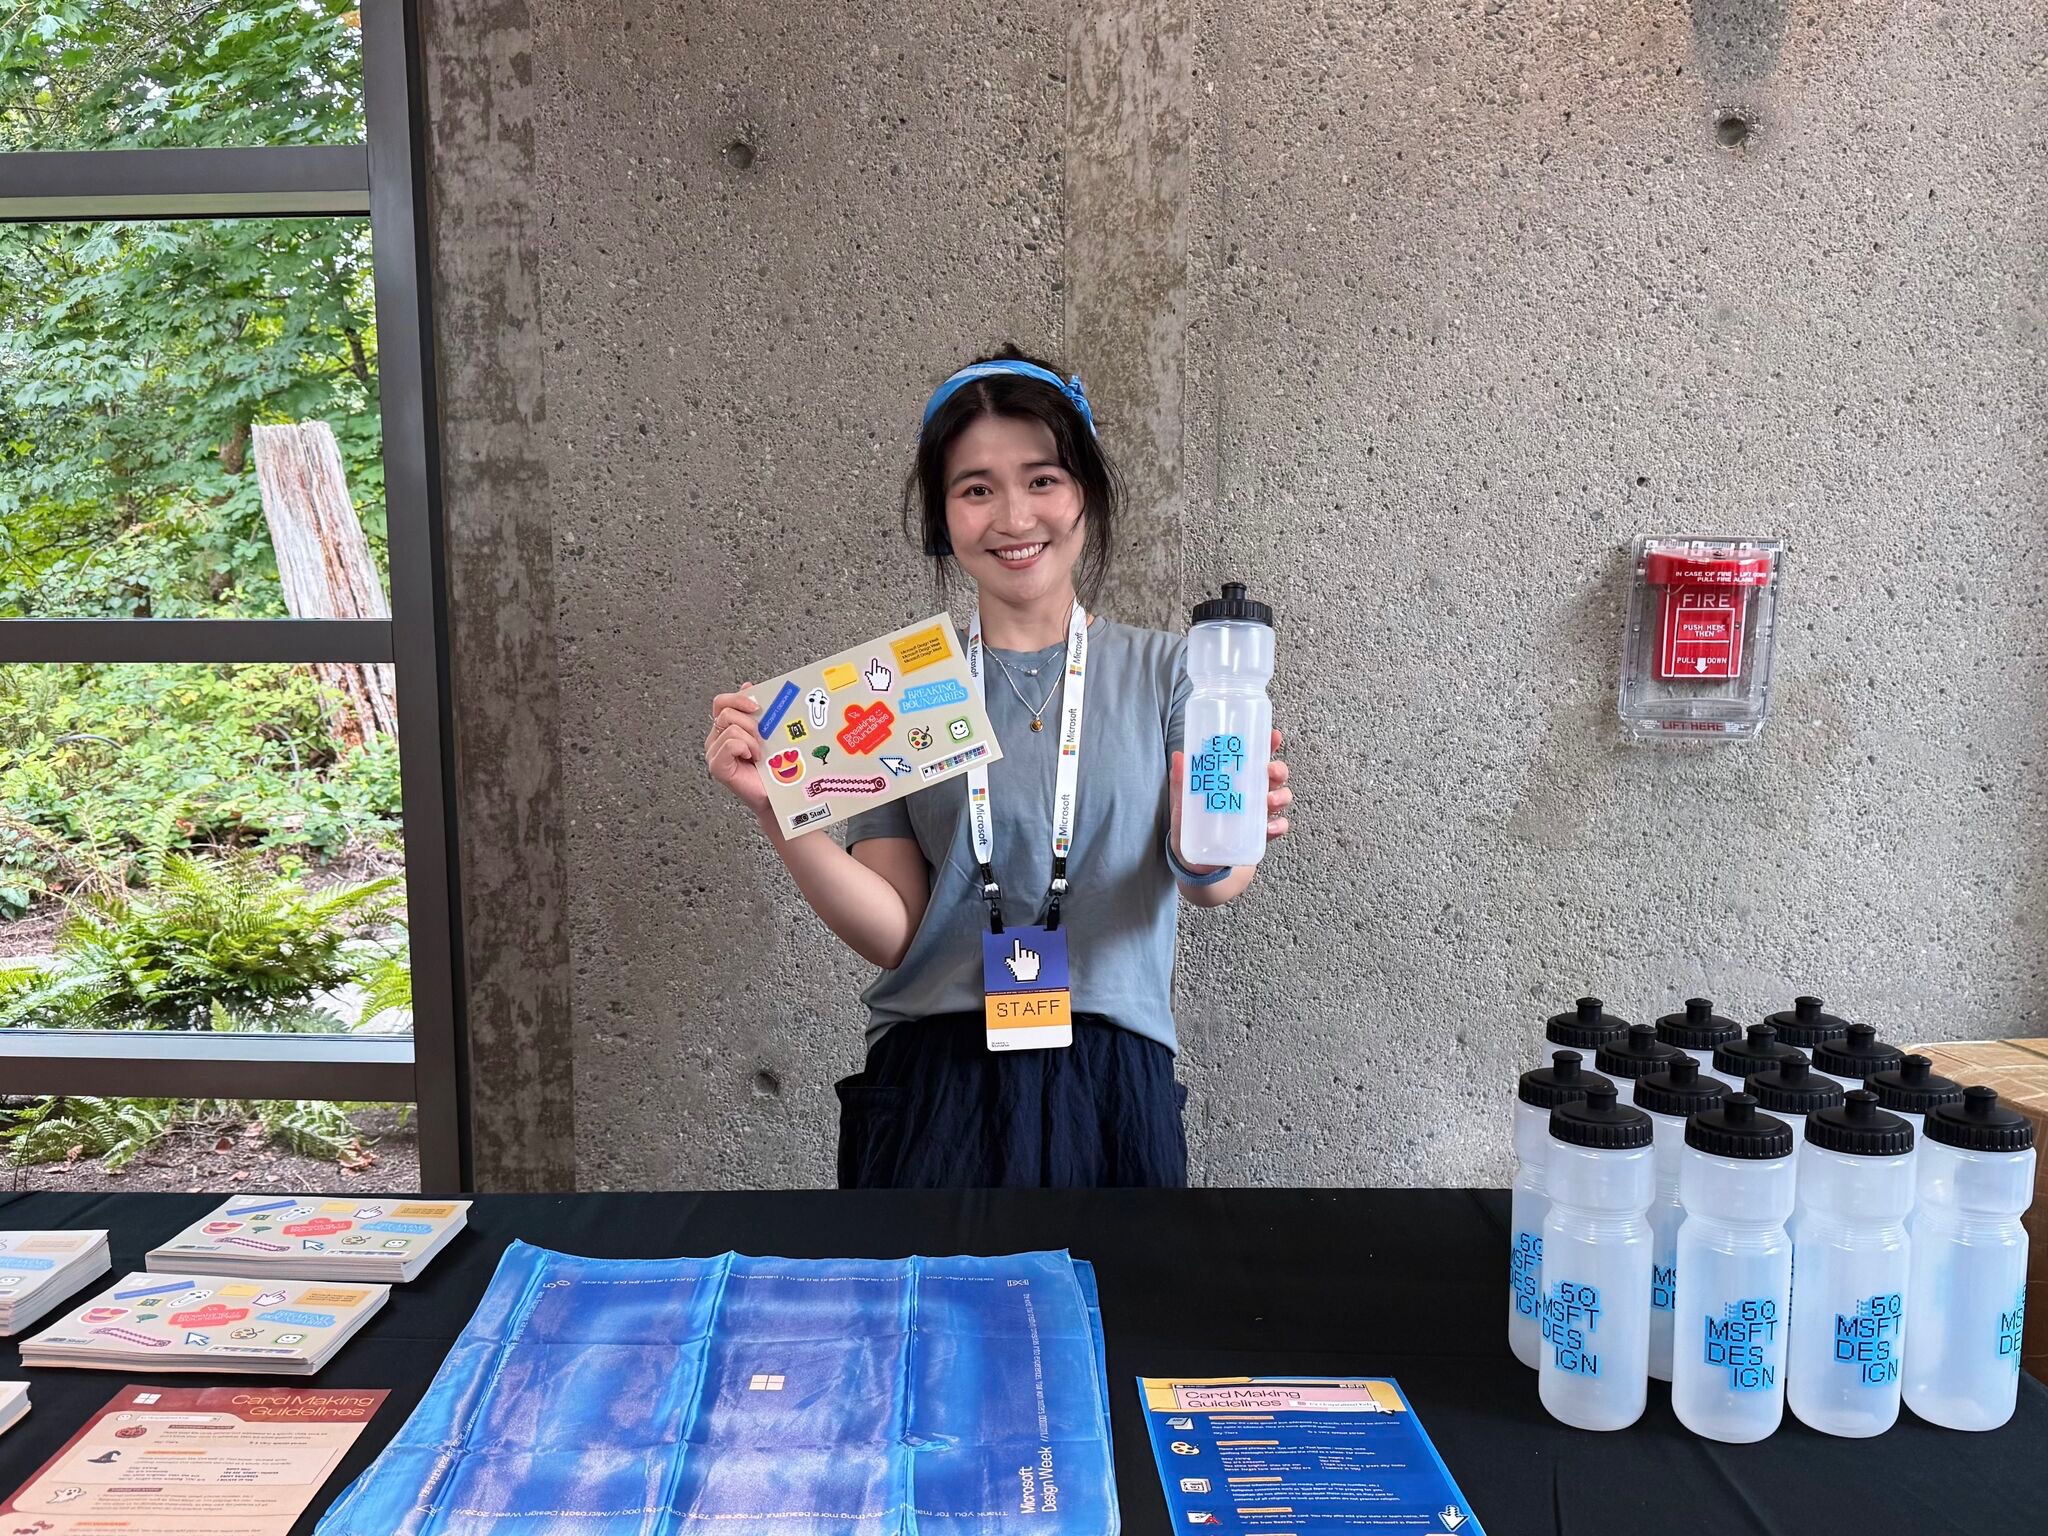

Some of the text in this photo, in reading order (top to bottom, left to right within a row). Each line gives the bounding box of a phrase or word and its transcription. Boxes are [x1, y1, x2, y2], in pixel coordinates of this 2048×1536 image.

[1682, 593, 1731, 608] FIRE
[1073, 632, 1084, 665] Microsoft
[970, 646, 980, 678] Microsoft
[902, 689, 966, 711] BOUNDARIES
[907, 681, 957, 700] BREAKING
[843, 714, 877, 743] Breaking
[1066, 708, 1077, 743] Microsoft
[1661, 720, 1686, 731] LIFT
[1690, 720, 1724, 731] HERE
[1212, 735, 1242, 753] 50
[1191, 752, 1244, 772] MSFT
[1190, 773, 1230, 792] DES
[1205, 792, 1242, 811] IGN
[809, 808, 827, 820] Start
[975, 803, 988, 846] Microsoft
[1058, 794, 1071, 836] Microsoft
[996, 999, 1061, 1018] STAFF
[1561, 1282, 1597, 1307] 50
[1871, 1294, 1901, 1317] 50
[1543, 1292, 1600, 1329] MSFT
[1741, 1299, 1776, 1321] 50
[1542, 1317, 1582, 1351] DES
[1708, 1317, 1778, 1342] MSFT
[1837, 1313, 1902, 1338] MSFT
[1555, 1346, 1597, 1375] IGN
[1708, 1341, 1763, 1366] DES
[1836, 1339, 1890, 1362] DES
[1733, 1365, 1775, 1388] IGN
[1862, 1358, 1898, 1383] IGN
[232, 1394, 376, 1408] Card Making
[1185, 1389, 1301, 1402] Card Making
[1187, 1400, 1282, 1408] Guidelines
[248, 1406, 366, 1418] Guidelines
[1038, 1446, 1053, 1480] Week
[1019, 1466, 1036, 1514] Microsoft
[1040, 1480, 1059, 1512] Design
[954, 1510, 975, 1518] you
